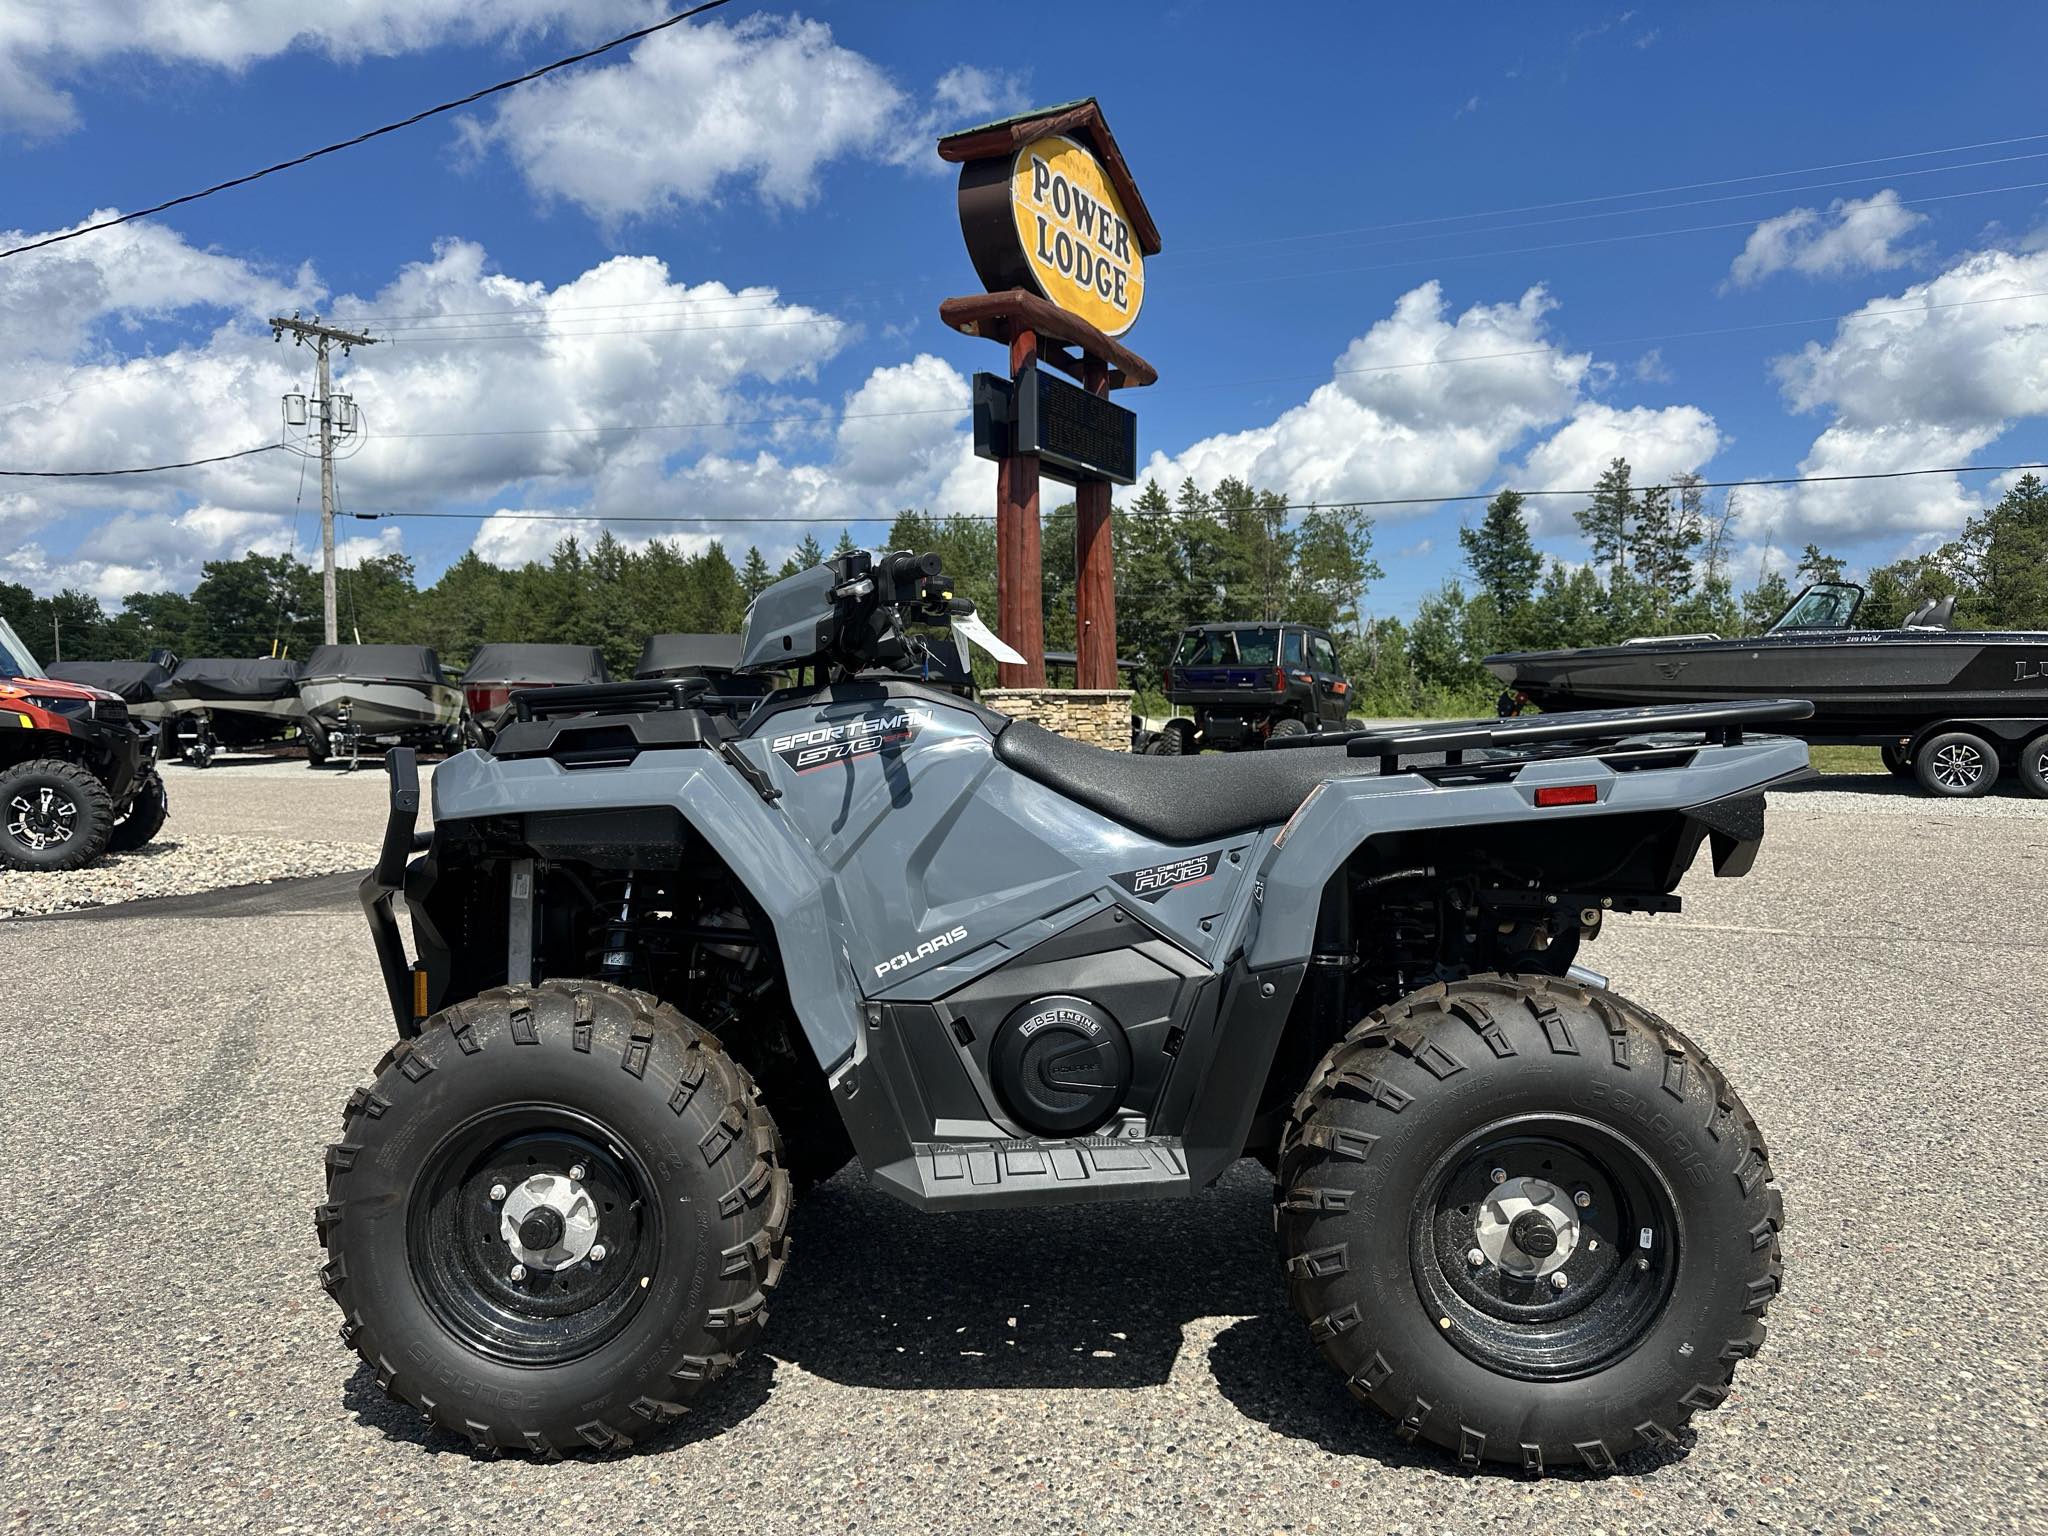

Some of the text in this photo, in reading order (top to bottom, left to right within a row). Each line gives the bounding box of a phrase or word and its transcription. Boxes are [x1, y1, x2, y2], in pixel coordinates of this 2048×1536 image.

[1032, 156, 1131, 264] POWER
[1035, 214, 1128, 310] LODGE
[772, 709, 934, 753] SPORTSMAN
[796, 734, 883, 766] 570
[1134, 862, 1208, 892] AWD
[873, 925, 968, 978] POLARIS
[1023, 1012, 1056, 1033] EBS
[1058, 1010, 1099, 1032] ENGINE
